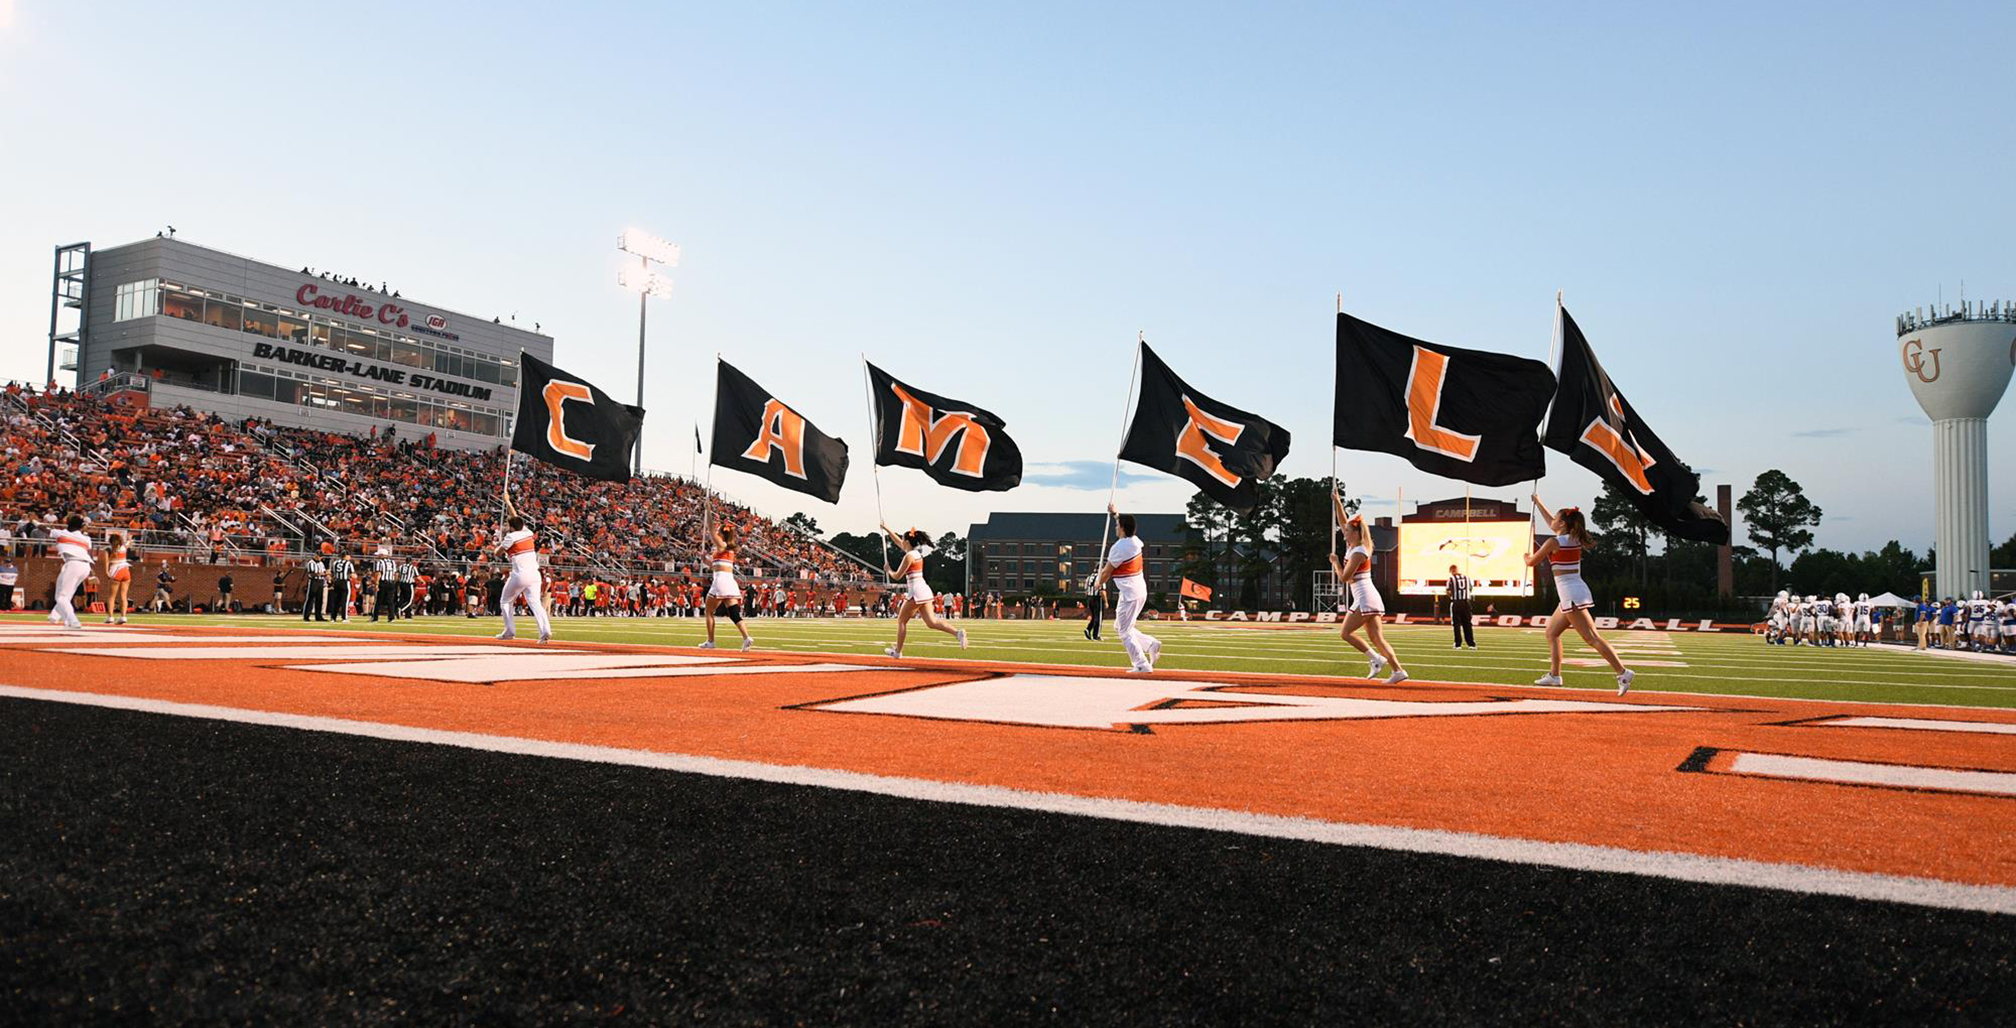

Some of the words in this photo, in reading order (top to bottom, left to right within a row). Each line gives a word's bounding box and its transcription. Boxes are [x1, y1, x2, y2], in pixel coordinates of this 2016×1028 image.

[296, 283, 374, 319] Carlie
[378, 303, 409, 328] C's
[253, 342, 406, 385] BARKER-LANE
[409, 373, 493, 401] STADIUM
[1404, 345, 1482, 463] L
[542, 378, 597, 462] C
[890, 381, 991, 478] M
[741, 397, 808, 481] A
[1435, 508, 1497, 518] CAMPBELL
[337, 562, 343, 572] S
[1458, 579, 1465, 589] U
[1624, 597, 1640, 609] 25
[1816, 604, 1828, 614] 30
[1860, 605, 1869, 615] 15
[1205, 610, 1414, 624] CAMPBL
[1471, 614, 1721, 631] FOOBALL
